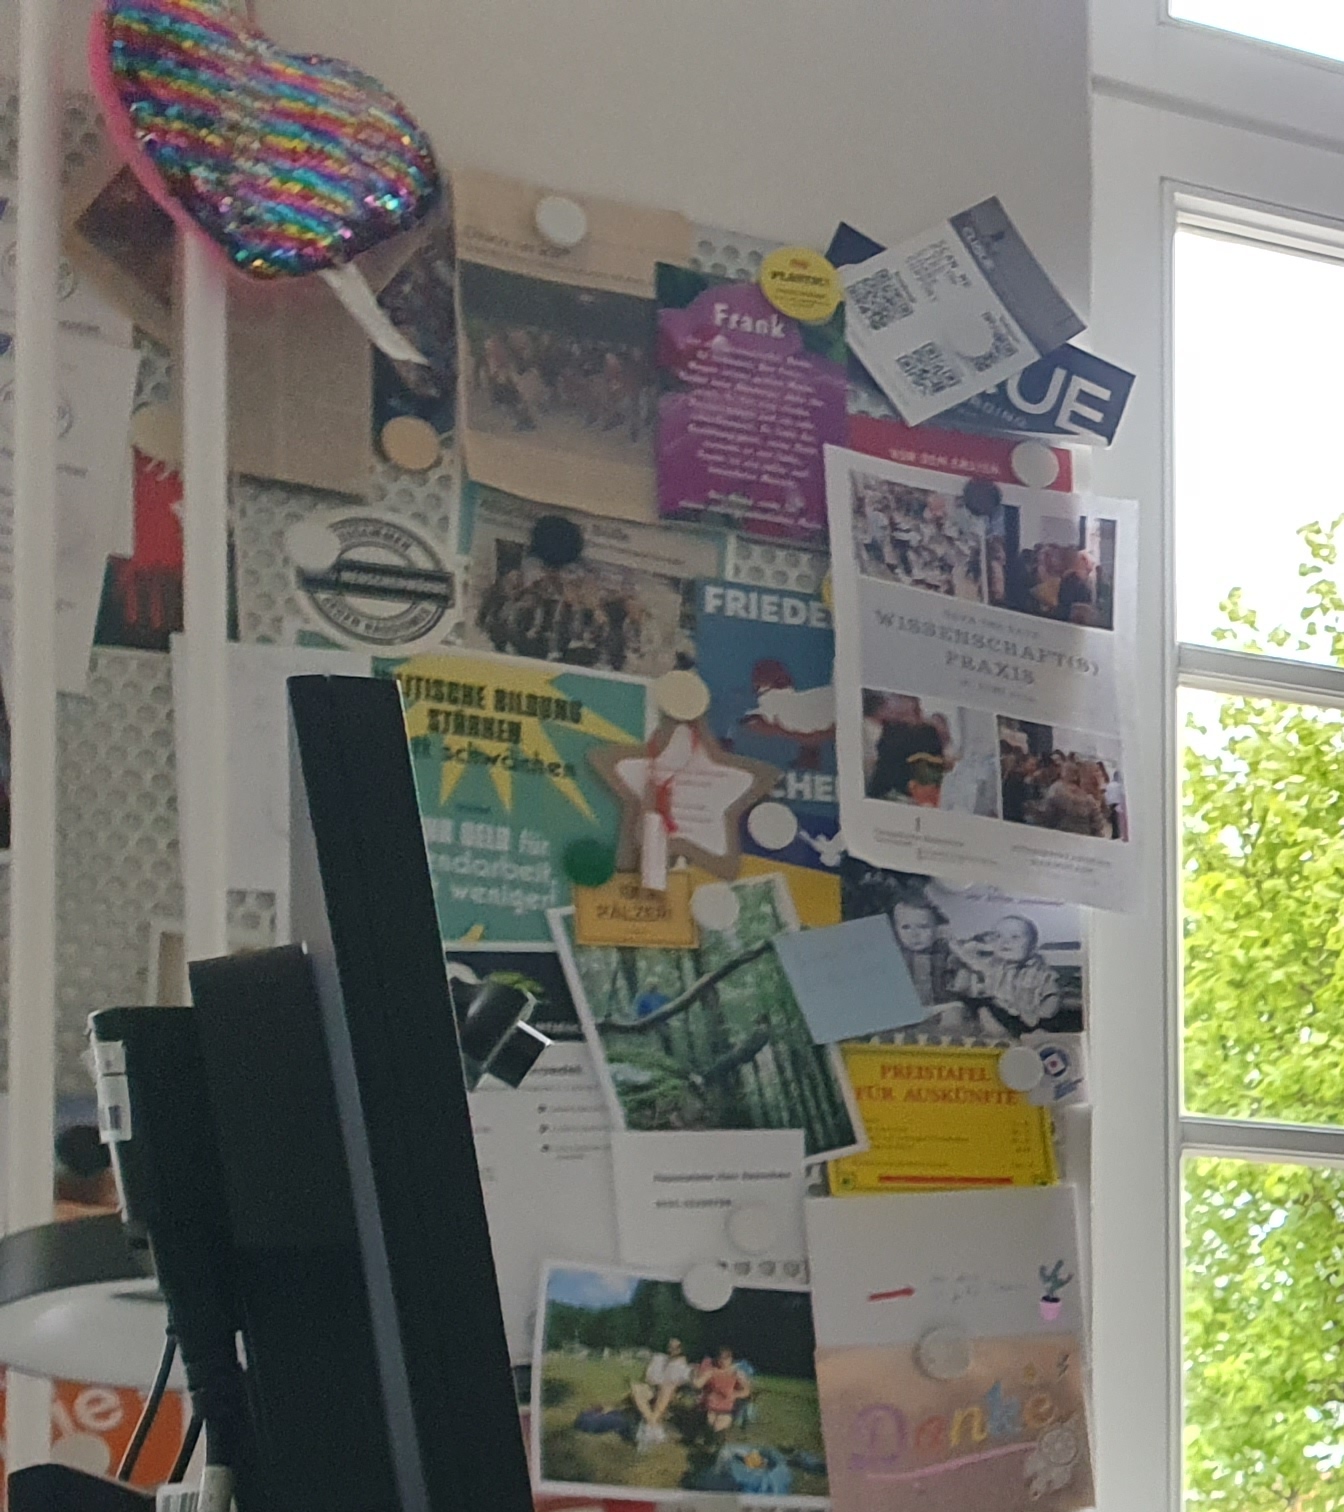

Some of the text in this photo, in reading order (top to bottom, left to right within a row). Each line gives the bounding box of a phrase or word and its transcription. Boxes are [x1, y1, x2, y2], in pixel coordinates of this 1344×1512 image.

[714, 303, 785, 338] Frank
[984, 367, 1112, 435] UE
[945, 651, 1034, 685] PRAXIS
